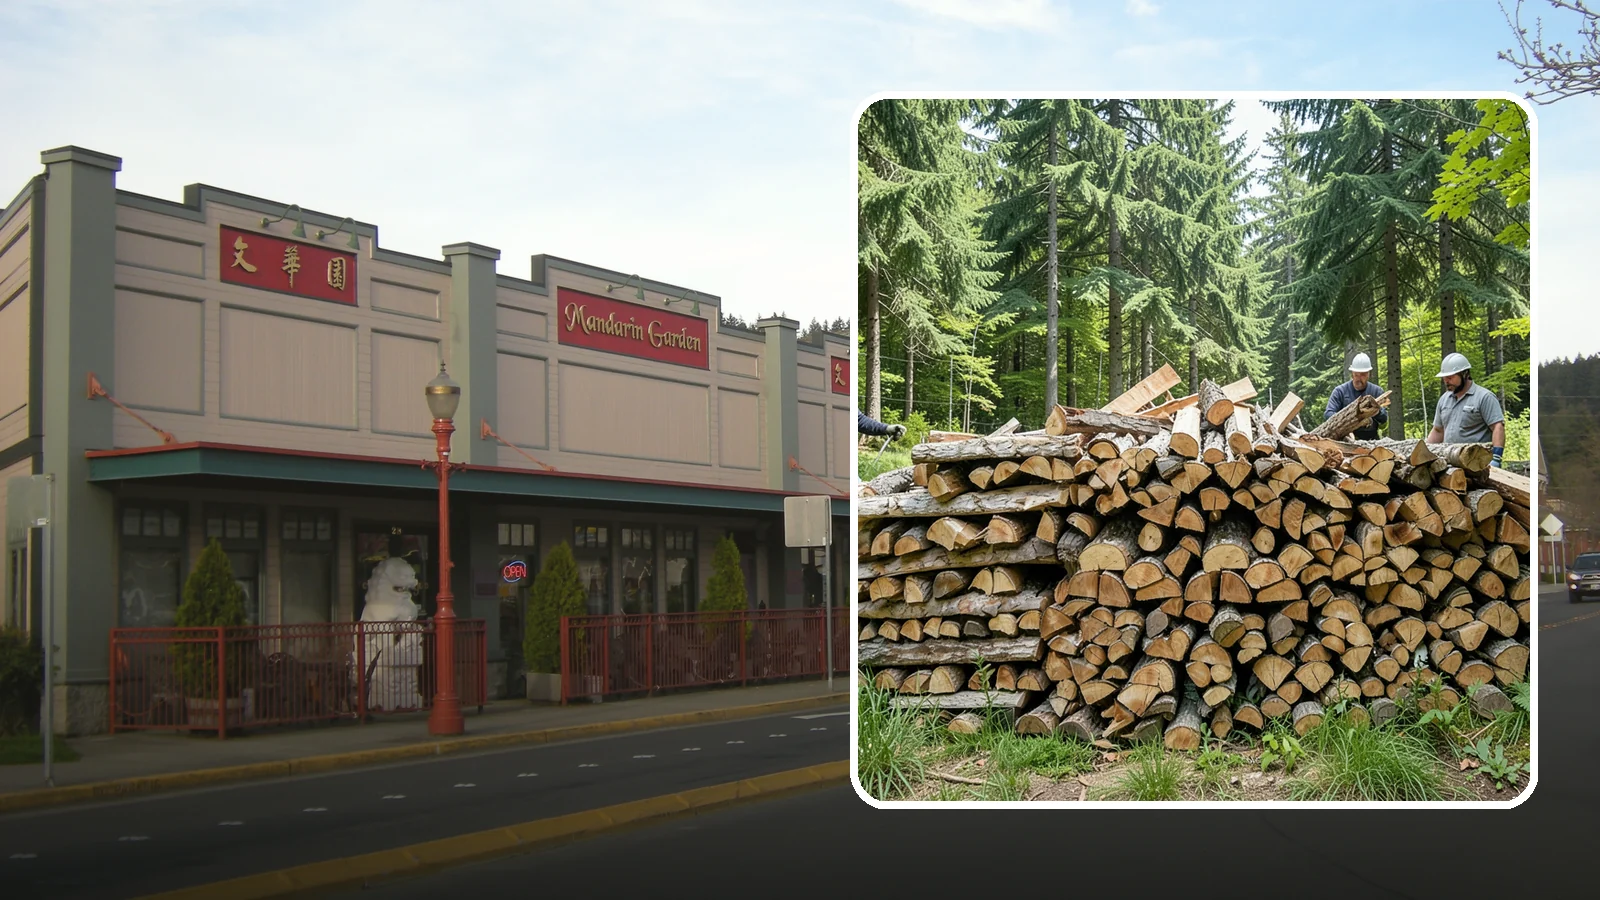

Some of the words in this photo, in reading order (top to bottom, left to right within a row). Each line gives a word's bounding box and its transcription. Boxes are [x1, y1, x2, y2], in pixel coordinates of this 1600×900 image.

[231, 236, 346, 291] 文華園
[564, 302, 644, 341] Mandarin
[647, 320, 701, 352] Garden
[503, 565, 526, 578] OPEN
